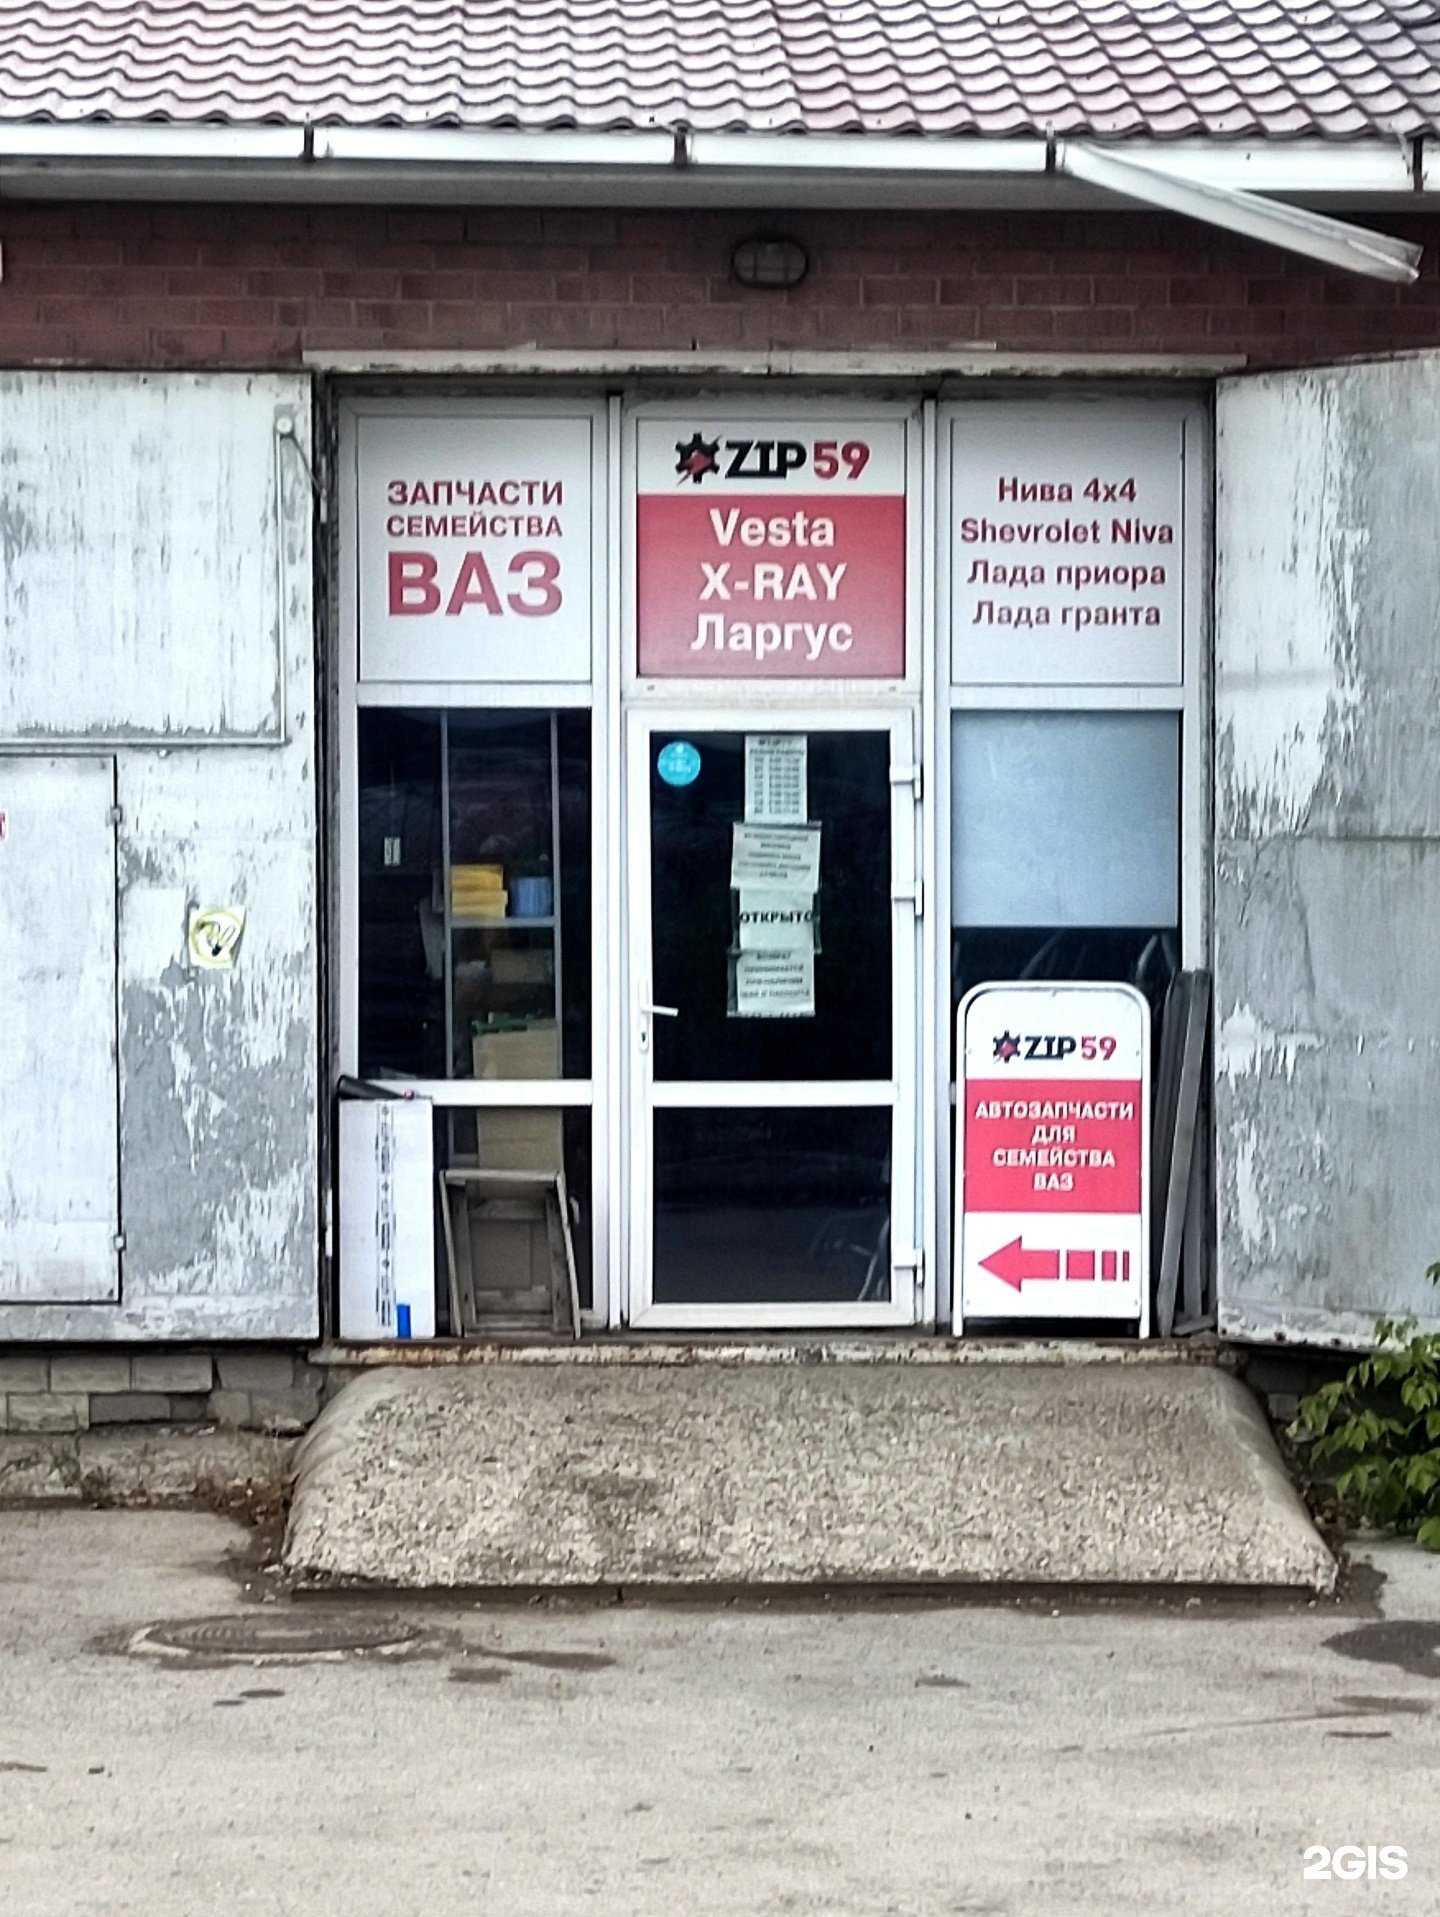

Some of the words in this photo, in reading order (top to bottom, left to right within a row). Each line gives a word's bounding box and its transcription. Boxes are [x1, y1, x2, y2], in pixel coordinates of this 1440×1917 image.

[387, 481, 563, 506] ЗАПЧАСТИ
[998, 477, 1072, 503] Нива
[386, 511, 563, 538] СЕМЕЙСТВА
[709, 508, 835, 547] Vesta
[960, 517, 1100, 544] Shevrolet
[1111, 517, 1174, 544] Niva
[388, 551, 562, 617] ВАЗ
[699, 562, 847, 601] X-RAY
[967, 560, 1045, 588] Лада
[1056, 564, 1166, 590] приора
[972, 601, 1050, 628] Лада
[1061, 604, 1161, 631] гранта
[691, 614, 853, 661] Ларгус
[740, 910, 814, 925] ОТКРЫТО
[975, 1101, 1134, 1120] АВТОЗАПЧАСТИ
[1031, 1125, 1076, 1145] ДЛЯ
[992, 1146, 1116, 1168] СЕМЕЙСТВА
[1033, 1173, 1074, 1192] ВАЗ
